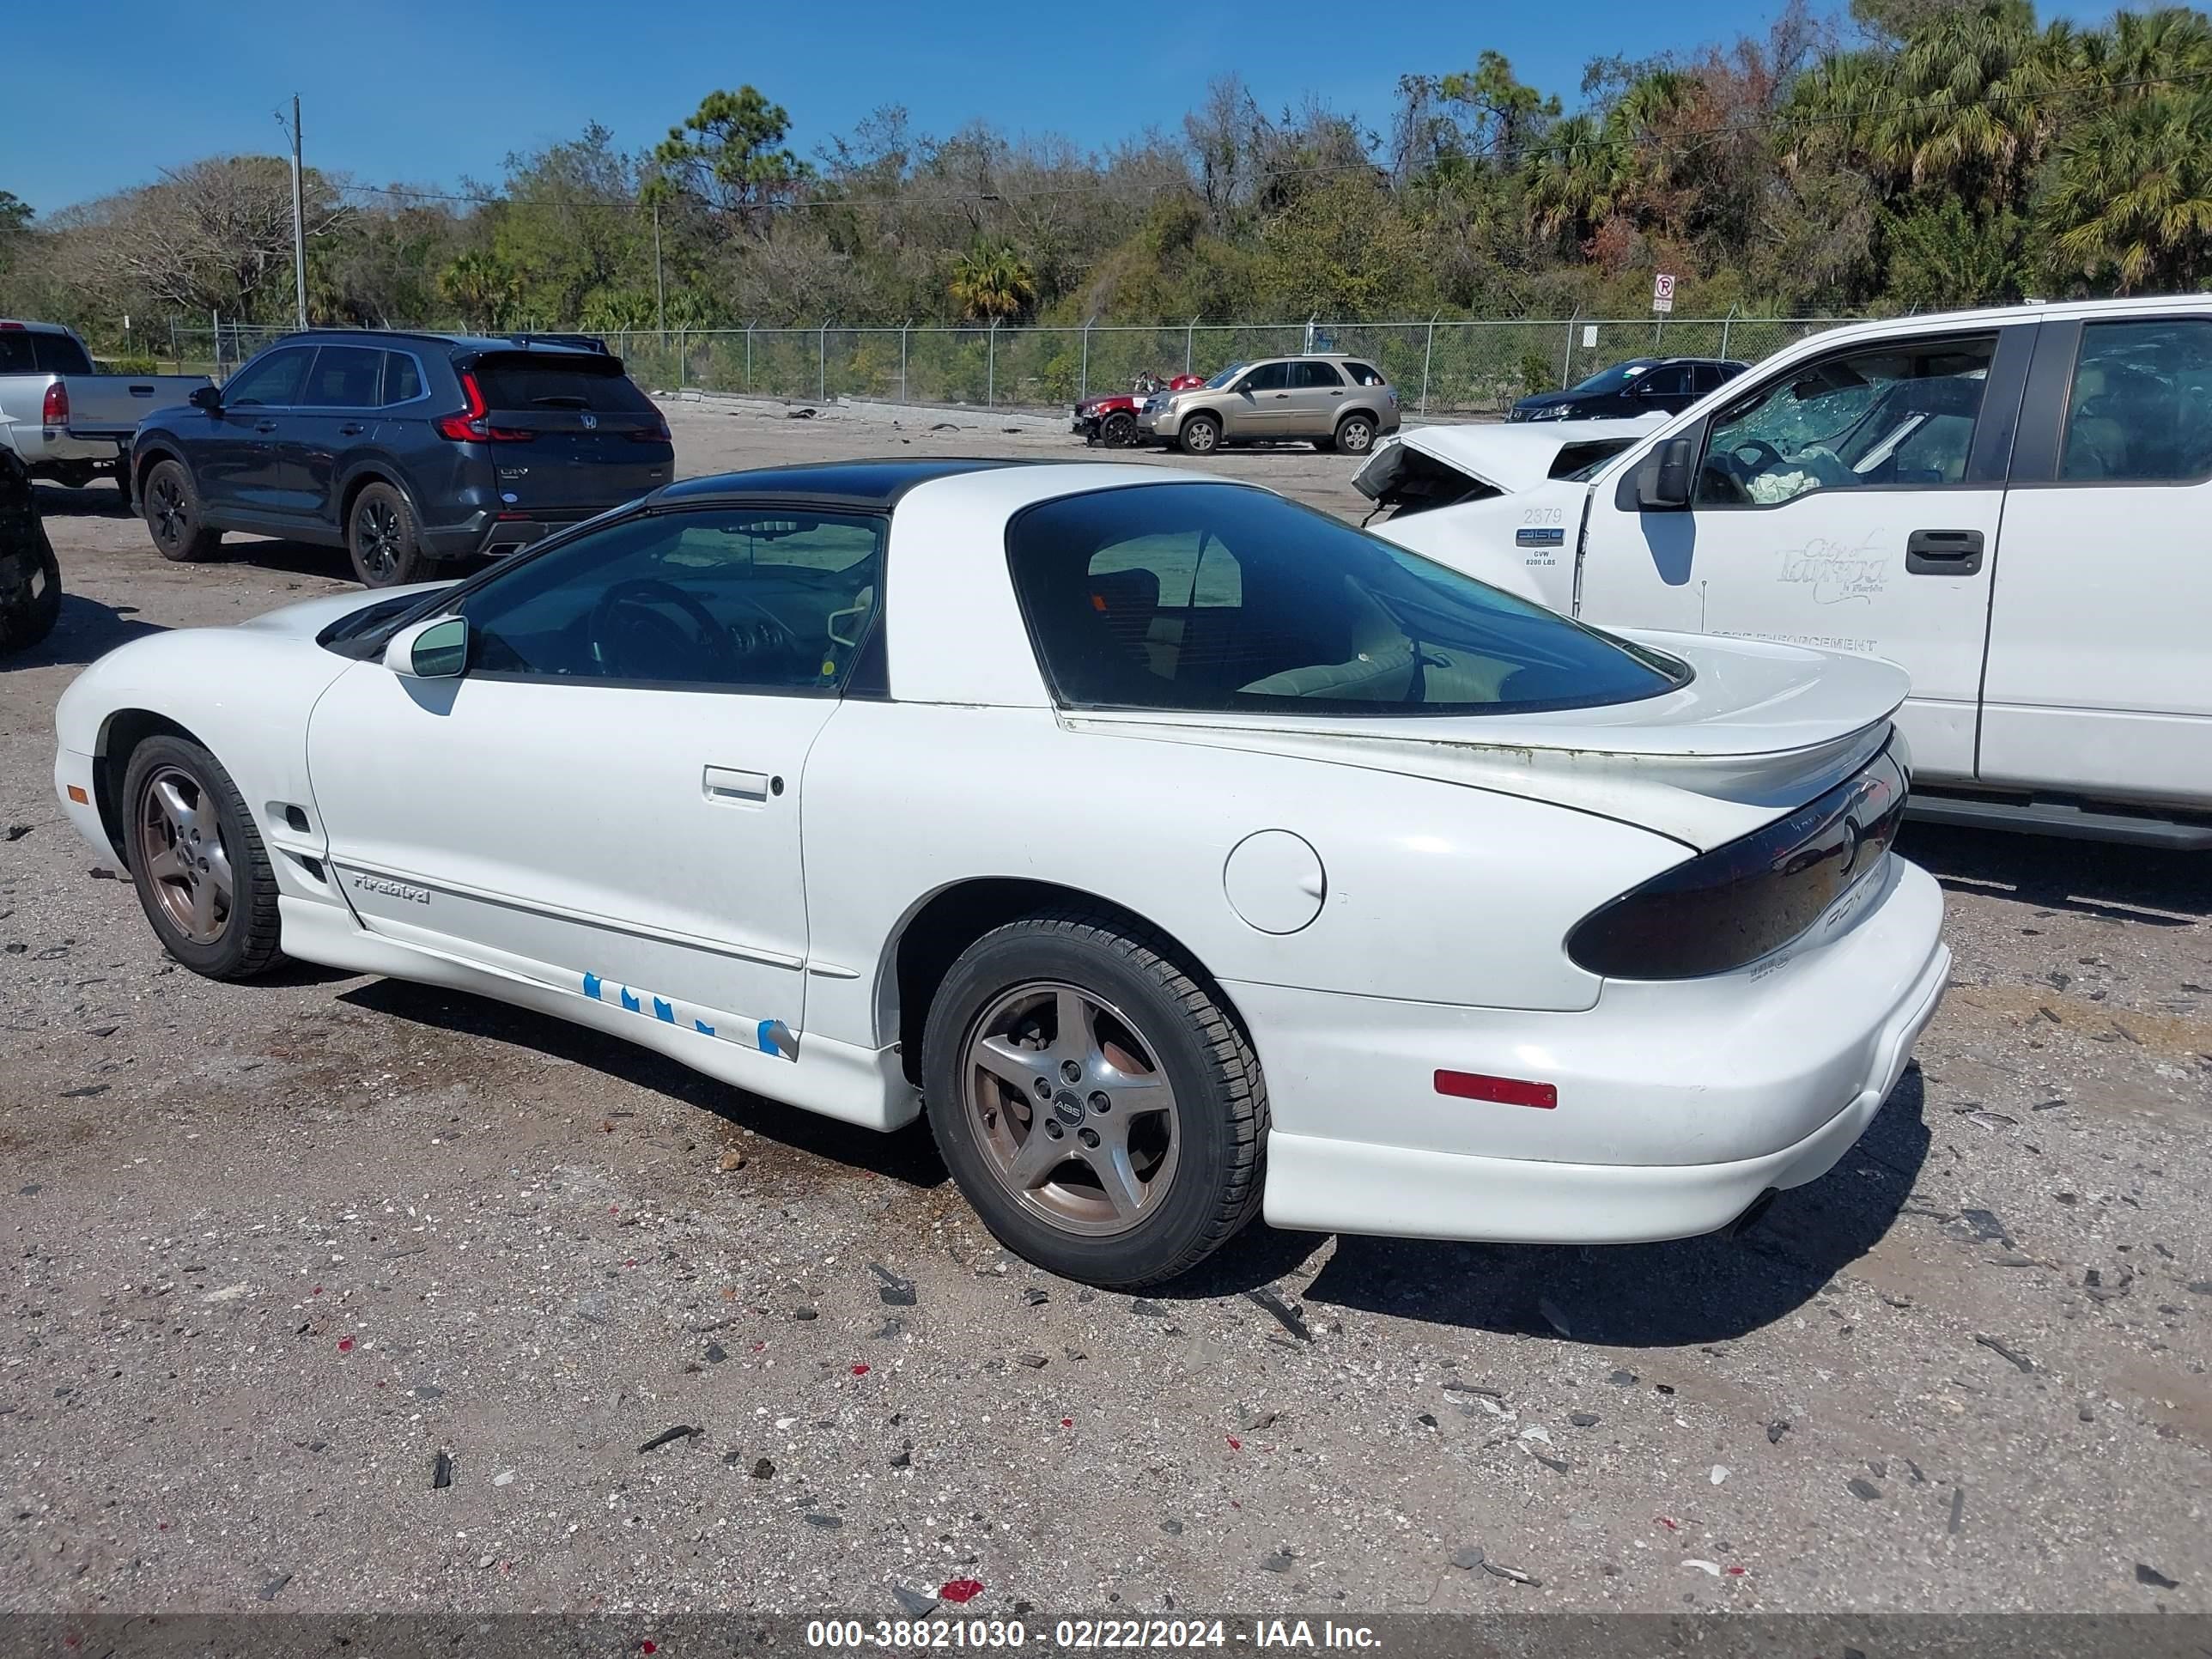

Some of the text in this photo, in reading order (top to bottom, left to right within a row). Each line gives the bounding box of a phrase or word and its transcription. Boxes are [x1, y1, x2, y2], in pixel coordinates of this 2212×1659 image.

[1524, 508, 1562, 524] 2379
[353, 872, 430, 905] Firebird
[1054, 1100, 1080, 1118] ABS
